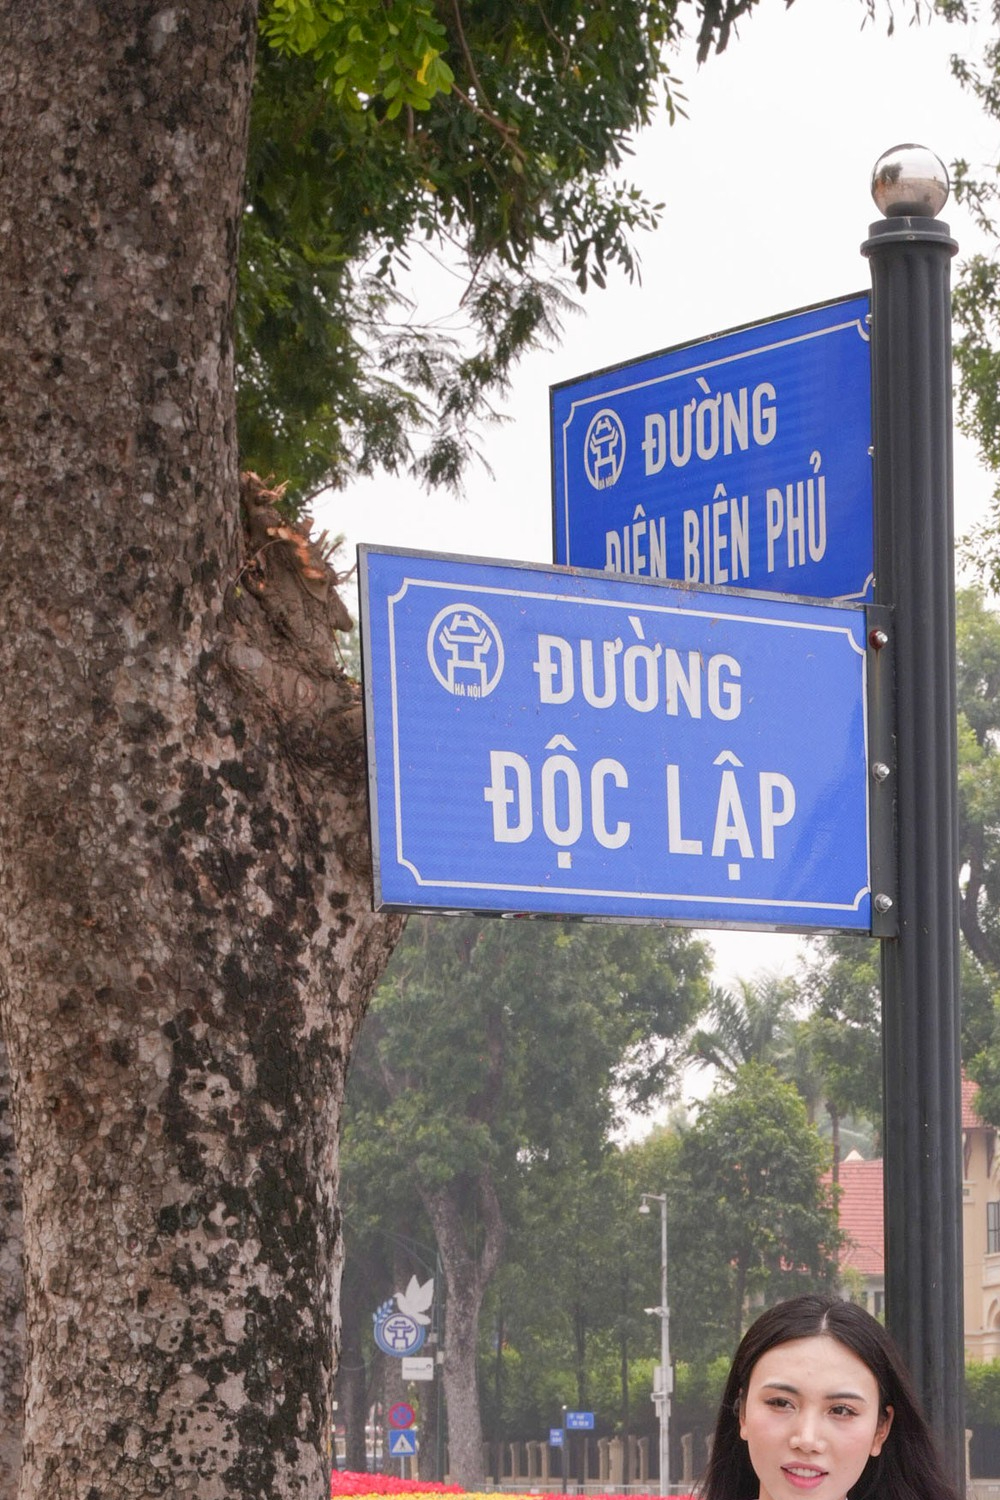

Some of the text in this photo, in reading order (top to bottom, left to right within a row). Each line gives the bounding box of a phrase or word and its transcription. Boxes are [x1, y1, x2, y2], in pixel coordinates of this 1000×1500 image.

[641, 376, 777, 476] ĐƯỜNG
[683, 482, 750, 585] BIÊN
[766, 450, 827, 573] PHỦ
[533, 615, 742, 721] ĐƯỜNG
[484, 734, 796, 880] ĐỘC LẬP
